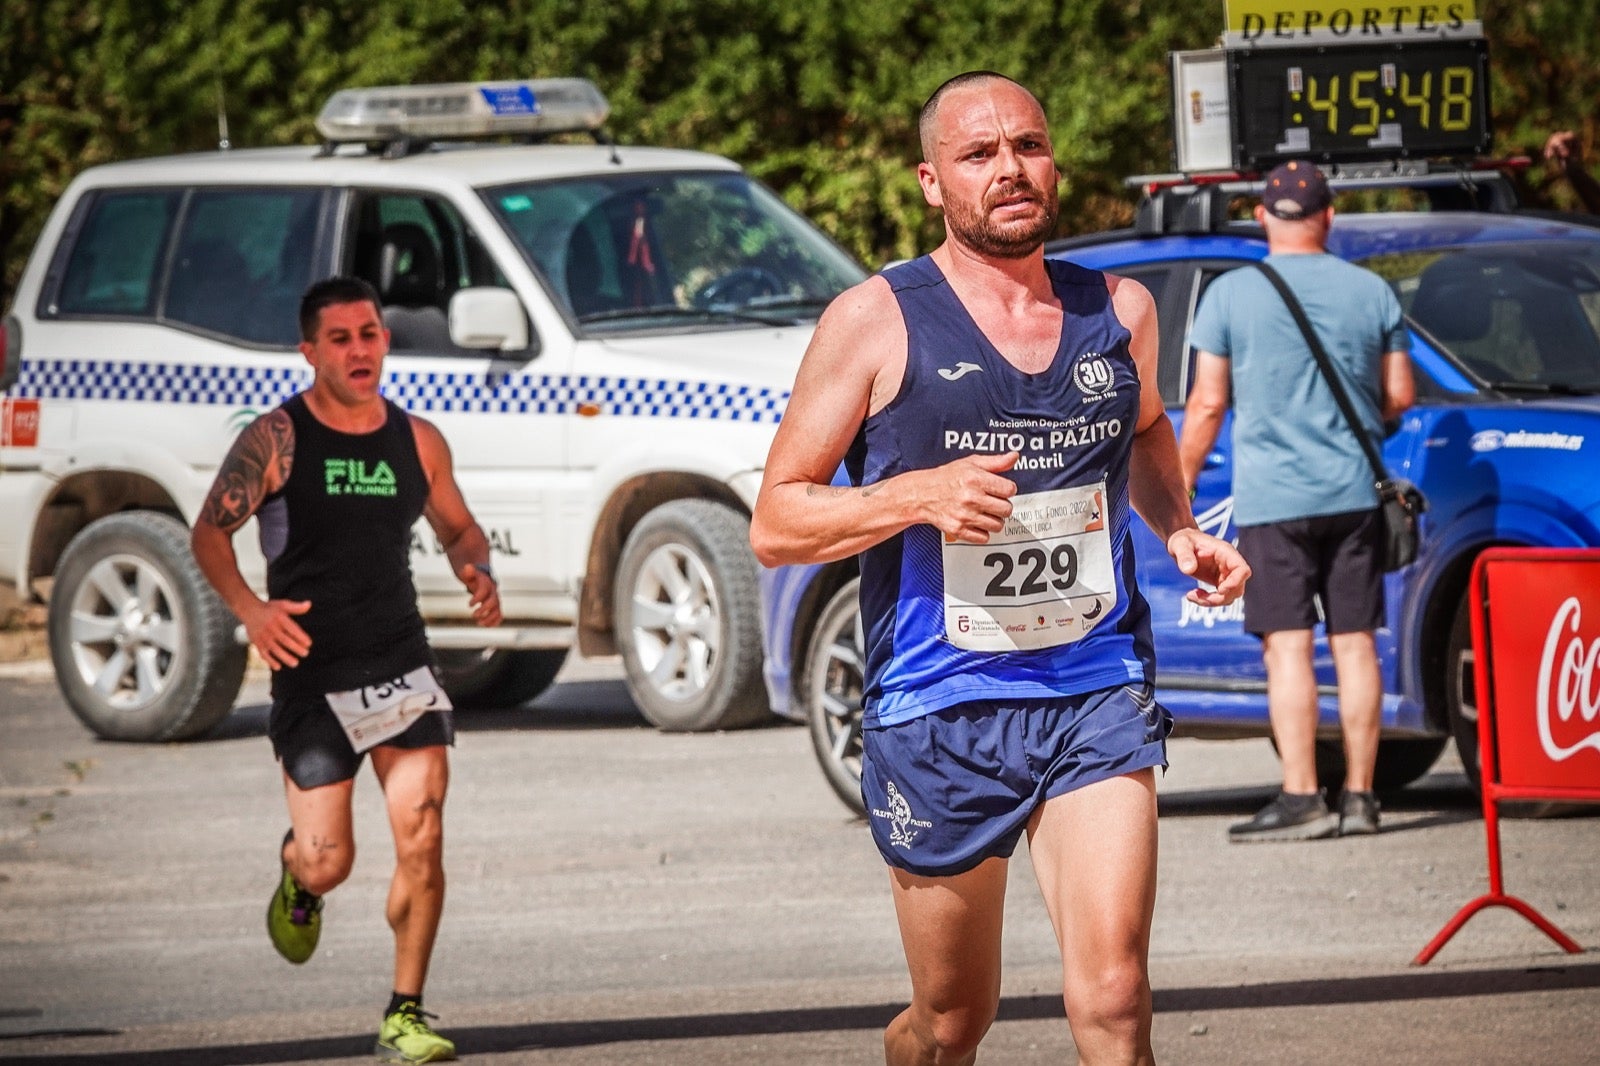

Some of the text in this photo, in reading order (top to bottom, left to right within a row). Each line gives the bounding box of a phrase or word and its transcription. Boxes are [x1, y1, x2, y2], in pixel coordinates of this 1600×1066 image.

[1242, 4, 1464, 40] DEPORTES
[1080, 360, 1108, 385] 30
[944, 418, 1121, 451] PAZITO a PAZITO
[989, 415, 1086, 430] Asociación Deportiva
[325, 458, 397, 484] FILA
[1013, 452, 1065, 471] Motril
[326, 484, 397, 496] BE A RUNNER
[1069, 500, 1088, 515] 2022
[983, 543, 1078, 597] 229
